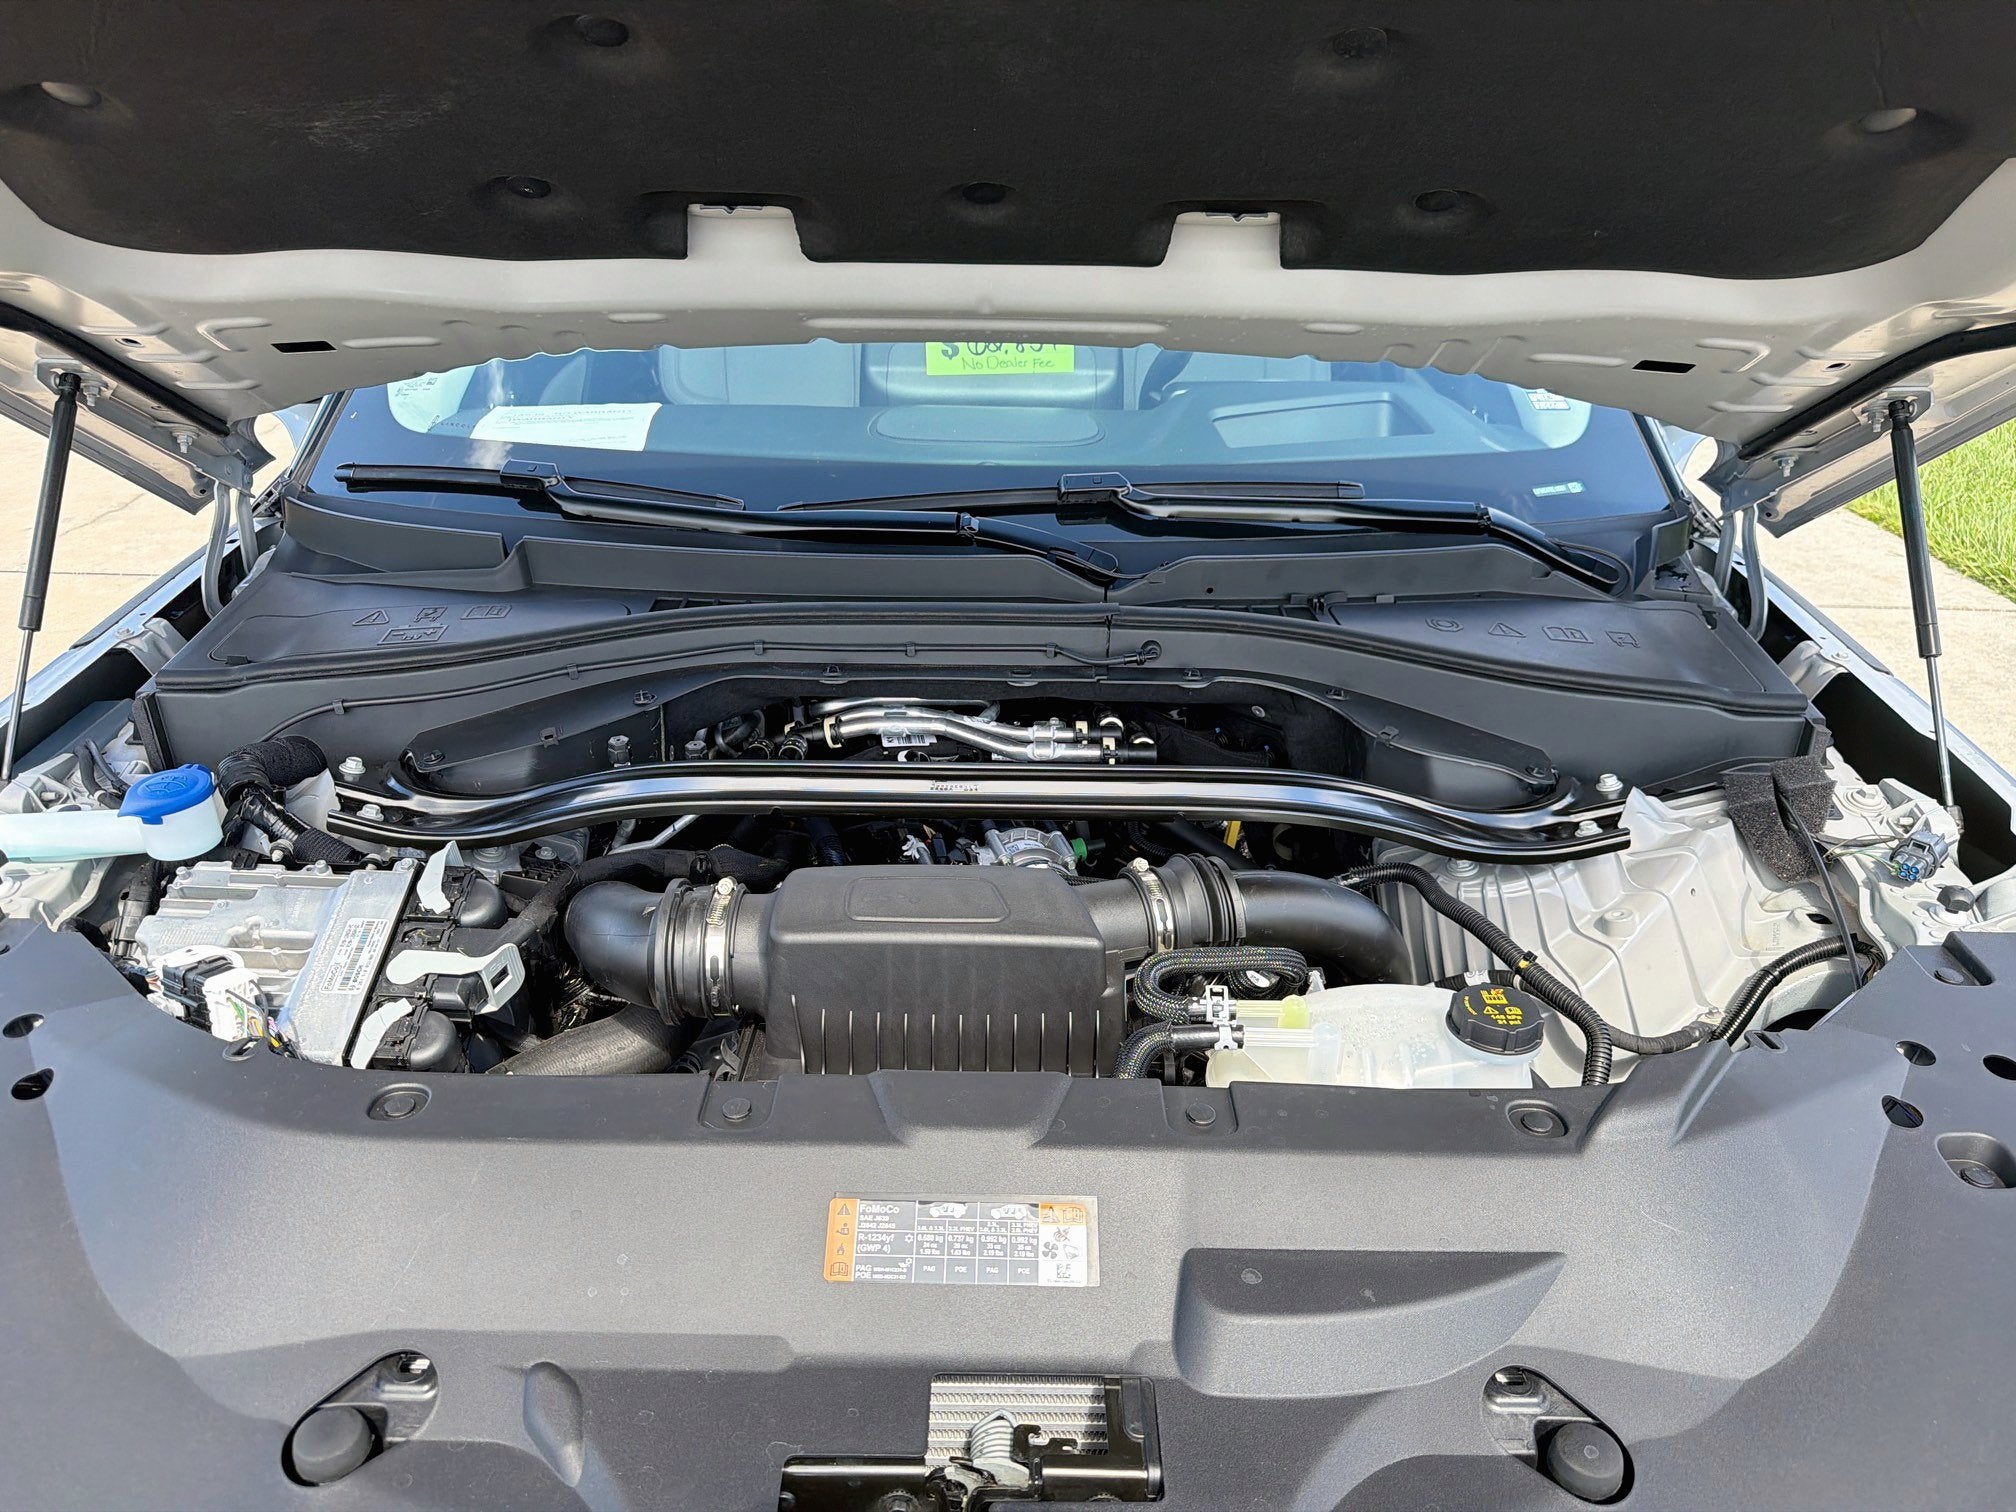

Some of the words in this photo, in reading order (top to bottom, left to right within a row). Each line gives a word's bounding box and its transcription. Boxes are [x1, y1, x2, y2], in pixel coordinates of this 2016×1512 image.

[961, 357, 983, 370] No
[986, 355, 1027, 370] Dealer
[1032, 358, 1055, 369] Fee
[860, 1204, 900, 1214] FoMoCo
[858, 1233, 895, 1243] R-1234yf
[935, 1234, 943, 1244] kg
[965, 1235, 974, 1244] kg
[998, 1235, 1007, 1245] kg
[1029, 1236, 1038, 1246] kg
[857, 1243, 881, 1254] (GWP
[882, 1244, 891, 1254] 4)
[855, 1264, 872, 1272] PAG
[954, 1265, 968, 1273] POE
[1017, 1267, 1031, 1275] POE
[855, 1271, 872, 1279] POE
